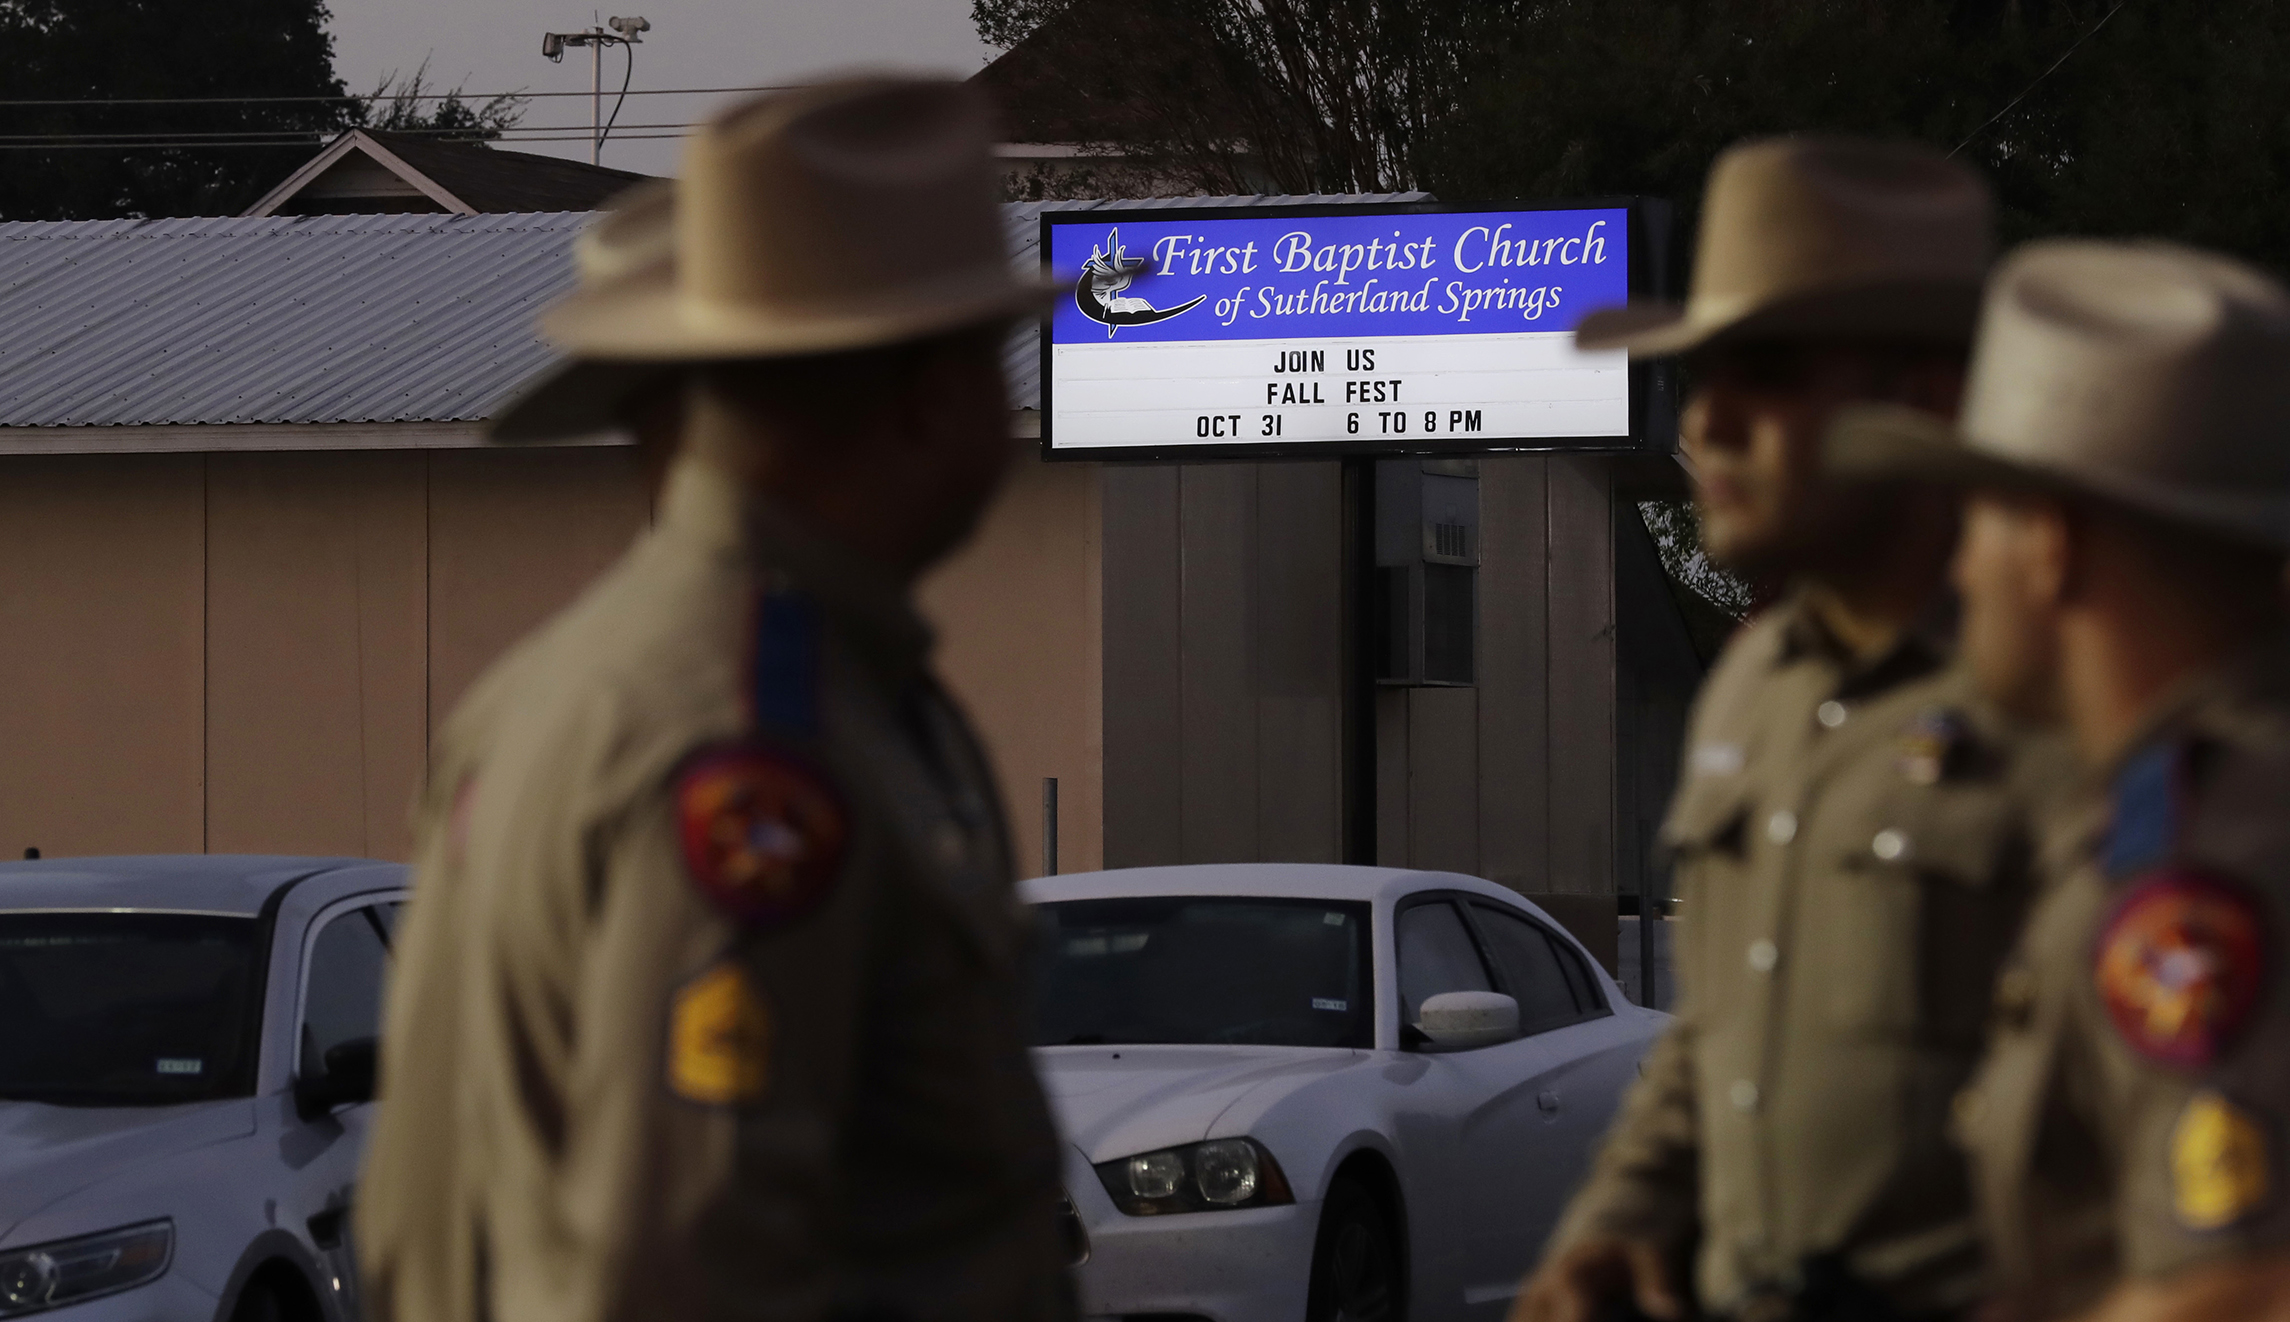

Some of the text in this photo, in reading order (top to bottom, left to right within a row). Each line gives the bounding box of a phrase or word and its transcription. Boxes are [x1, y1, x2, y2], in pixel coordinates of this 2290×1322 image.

[1153, 221, 1607, 285] First Baptist Church
[1215, 277, 1562, 326] of Sutherland Springs
[1274, 349, 1375, 373] JOIN US
[1267, 380, 1402, 405] FALL FEST
[1197, 410, 1482, 437] OCT 31 6 TO 8 PM
